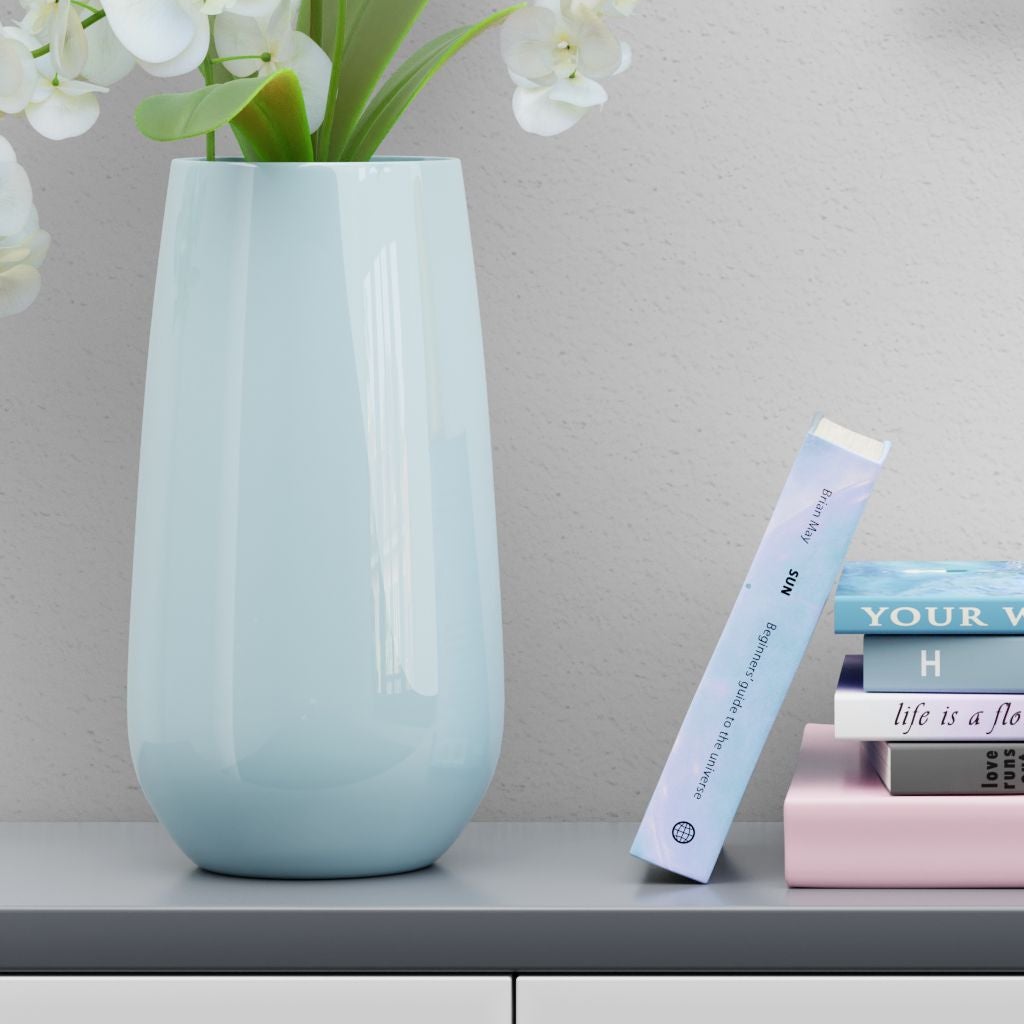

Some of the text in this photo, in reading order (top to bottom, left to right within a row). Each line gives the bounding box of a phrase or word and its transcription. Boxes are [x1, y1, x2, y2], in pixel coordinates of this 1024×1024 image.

[800, 488, 833, 544] Brian May
[780, 568, 799, 596] SUN
[860, 606, 989, 627] YOUR
[729, 680, 749, 714] guide
[723, 716, 735, 728] to
[894, 702, 930, 735] life
[941, 705, 959, 726] is
[968, 710, 984, 726] a
[713, 730, 729, 751] the
[693, 752, 718, 800] universe
[981, 750, 998, 788] love
[1004, 748, 1016, 789] runs
